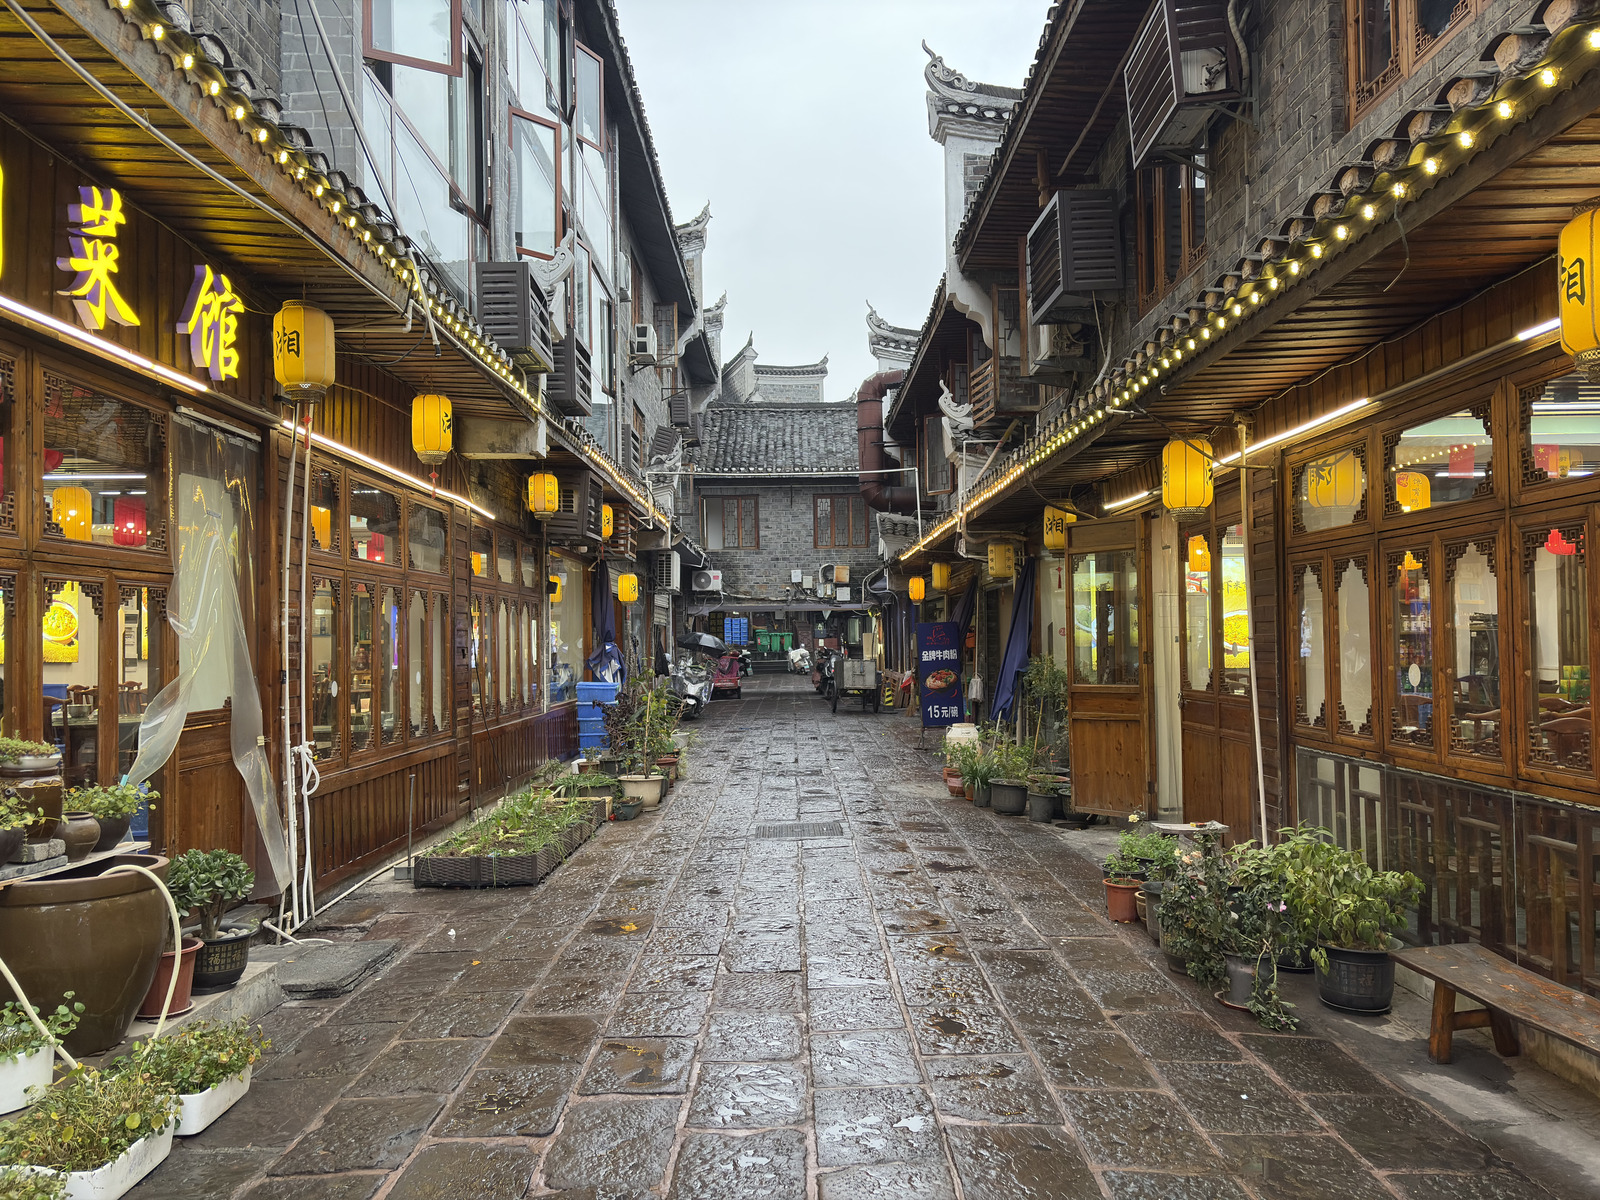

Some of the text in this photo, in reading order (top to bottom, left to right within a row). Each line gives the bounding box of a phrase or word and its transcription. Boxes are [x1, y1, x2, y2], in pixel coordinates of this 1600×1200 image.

[276, 326, 300, 361] 湘
[1045, 515, 1064, 535] 湘
[921, 649, 958, 662] 金牌牛肉粉
[208, 953, 221, 965] 福
